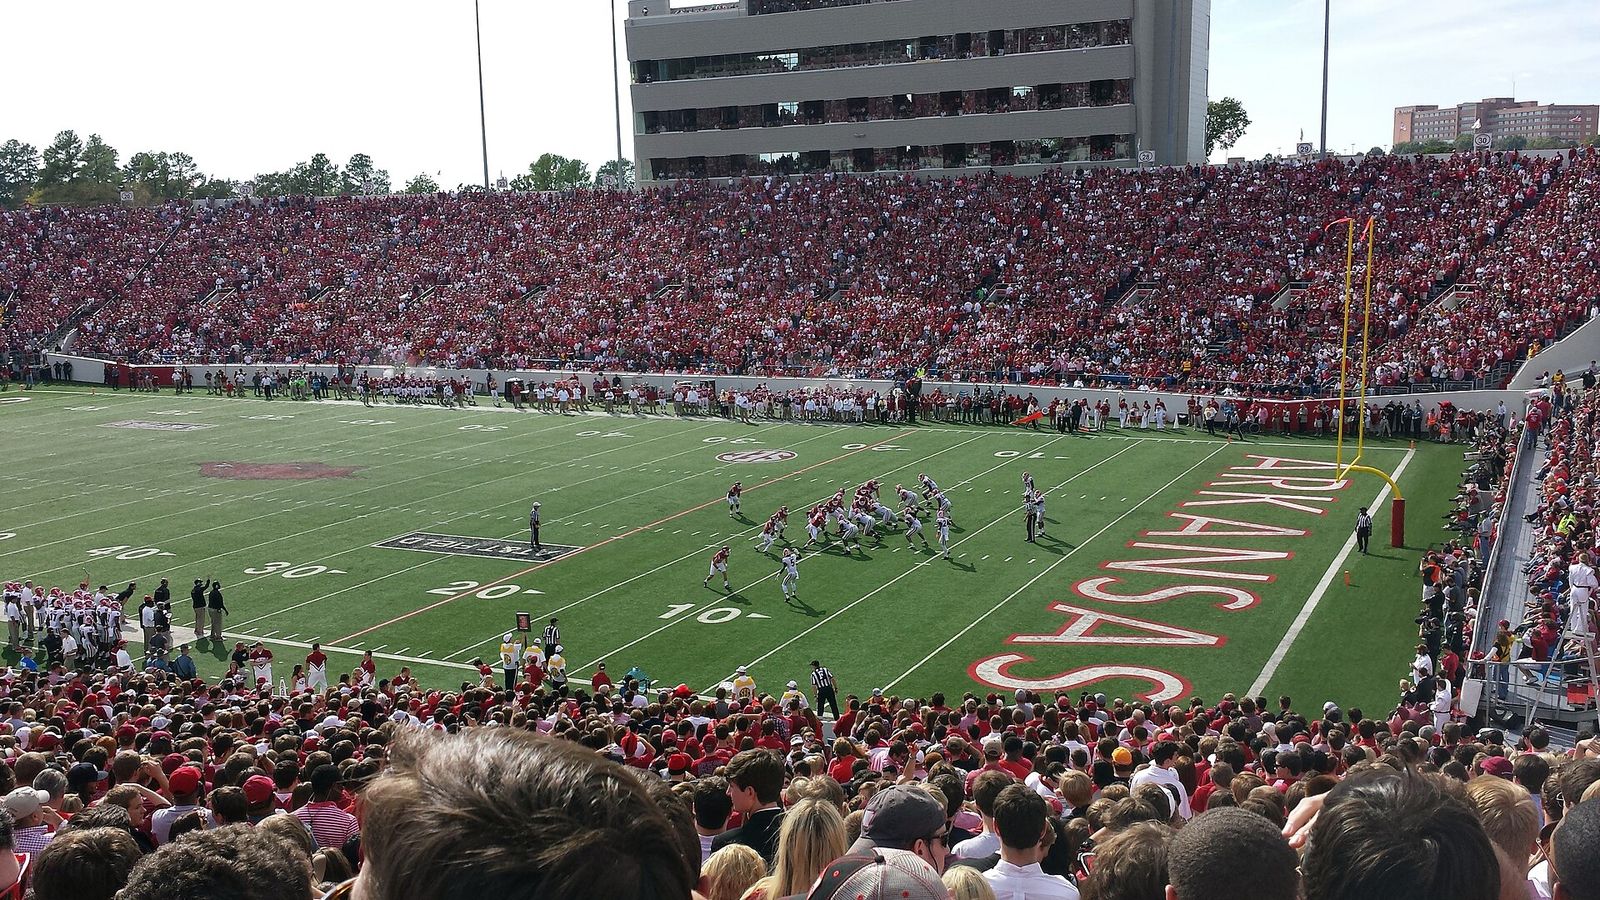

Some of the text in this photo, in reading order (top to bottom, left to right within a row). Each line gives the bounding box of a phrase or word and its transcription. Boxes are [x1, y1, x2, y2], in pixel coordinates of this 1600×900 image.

[575, 430, 631, 438] 40
[702, 436, 757, 444] 30
[841, 443, 901, 451] 20
[993, 450, 1046, 459] 10
[399, 537, 479, 549] FIELD
[85, 545, 161, 560] 40
[244, 561, 328, 578] 30
[966, 453, 1353, 703] ARKANSAS
[426, 580, 521, 600] 20
[657, 602, 742, 624] 10
